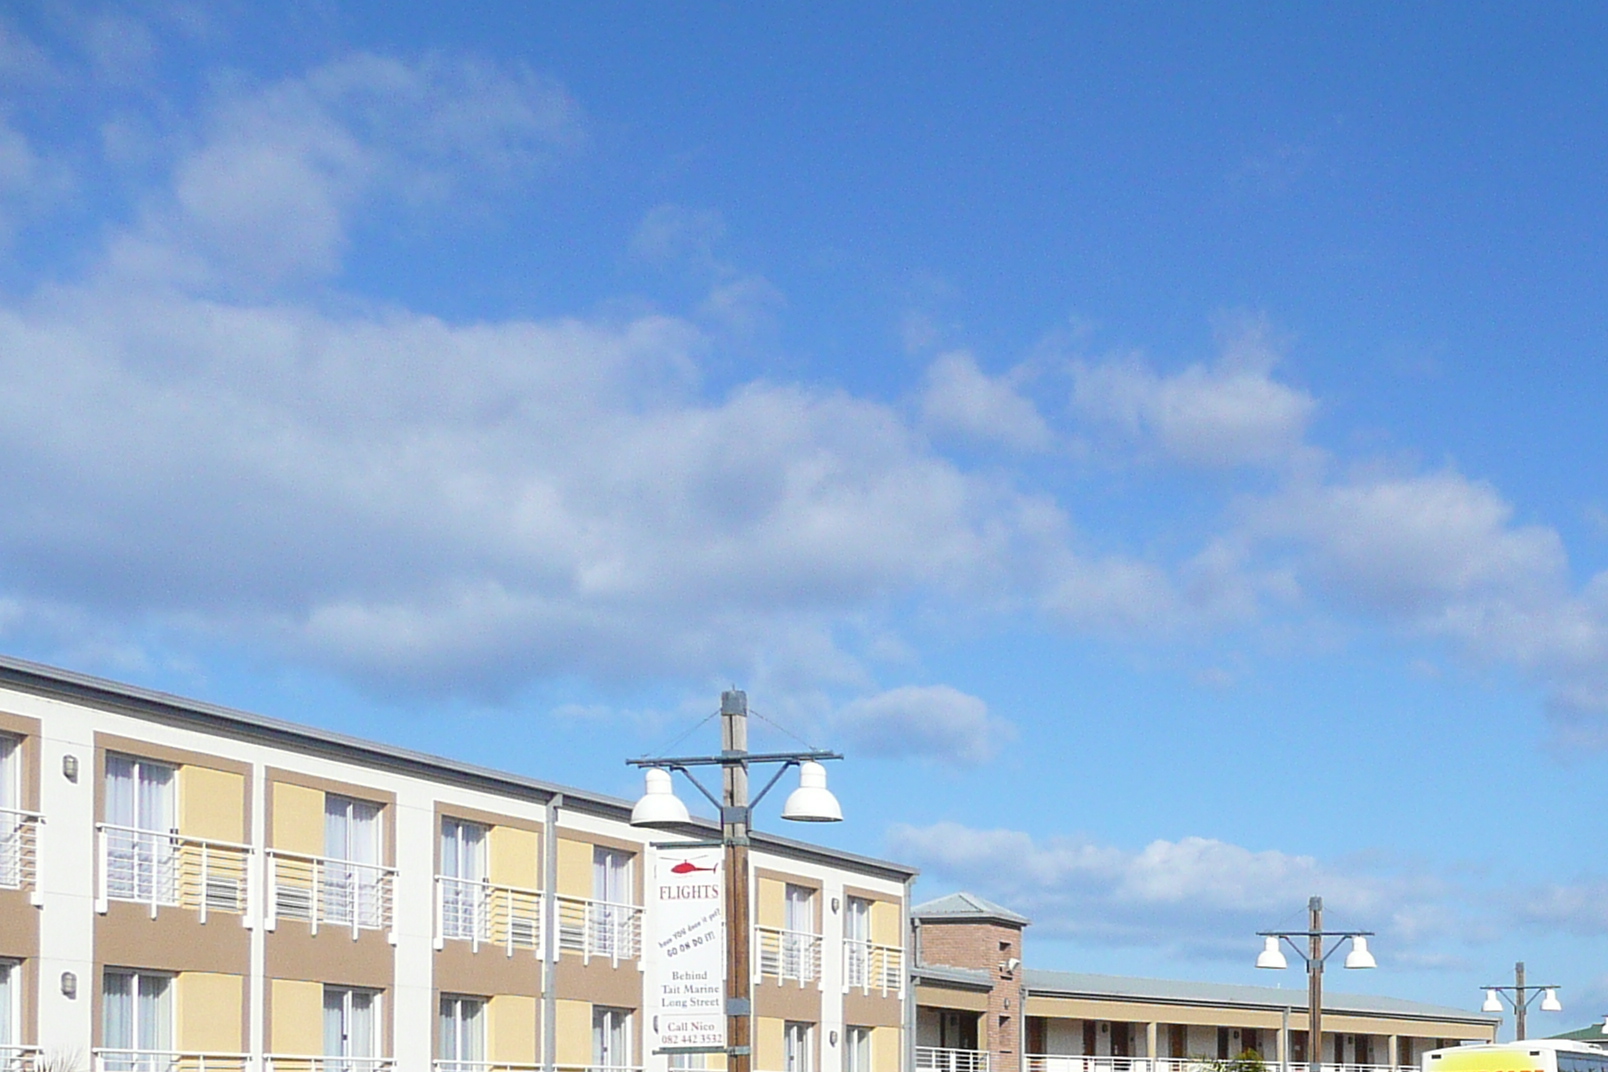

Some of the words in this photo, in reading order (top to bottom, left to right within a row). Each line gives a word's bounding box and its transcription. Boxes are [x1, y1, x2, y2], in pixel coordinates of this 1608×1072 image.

[659, 885, 719, 900] FLIGHTS
[672, 927, 687, 940] YOU
[687, 922, 701, 932] done
[667, 946, 678, 957] GO
[679, 941, 691, 953] ON
[691, 936, 703, 947] DO
[672, 970, 707, 980] Behind
[661, 984, 680, 994] Tait
[683, 984, 720, 994] Marine
[662, 998, 687, 1009] Long
[690, 997, 719, 1007] Street
[668, 1022, 688, 1032] Call
[690, 1021, 715, 1031] Nico
[661, 1034, 678, 1044] 082
[681, 1034, 698, 1044] 442
[700, 1033, 722, 1043] 3532
